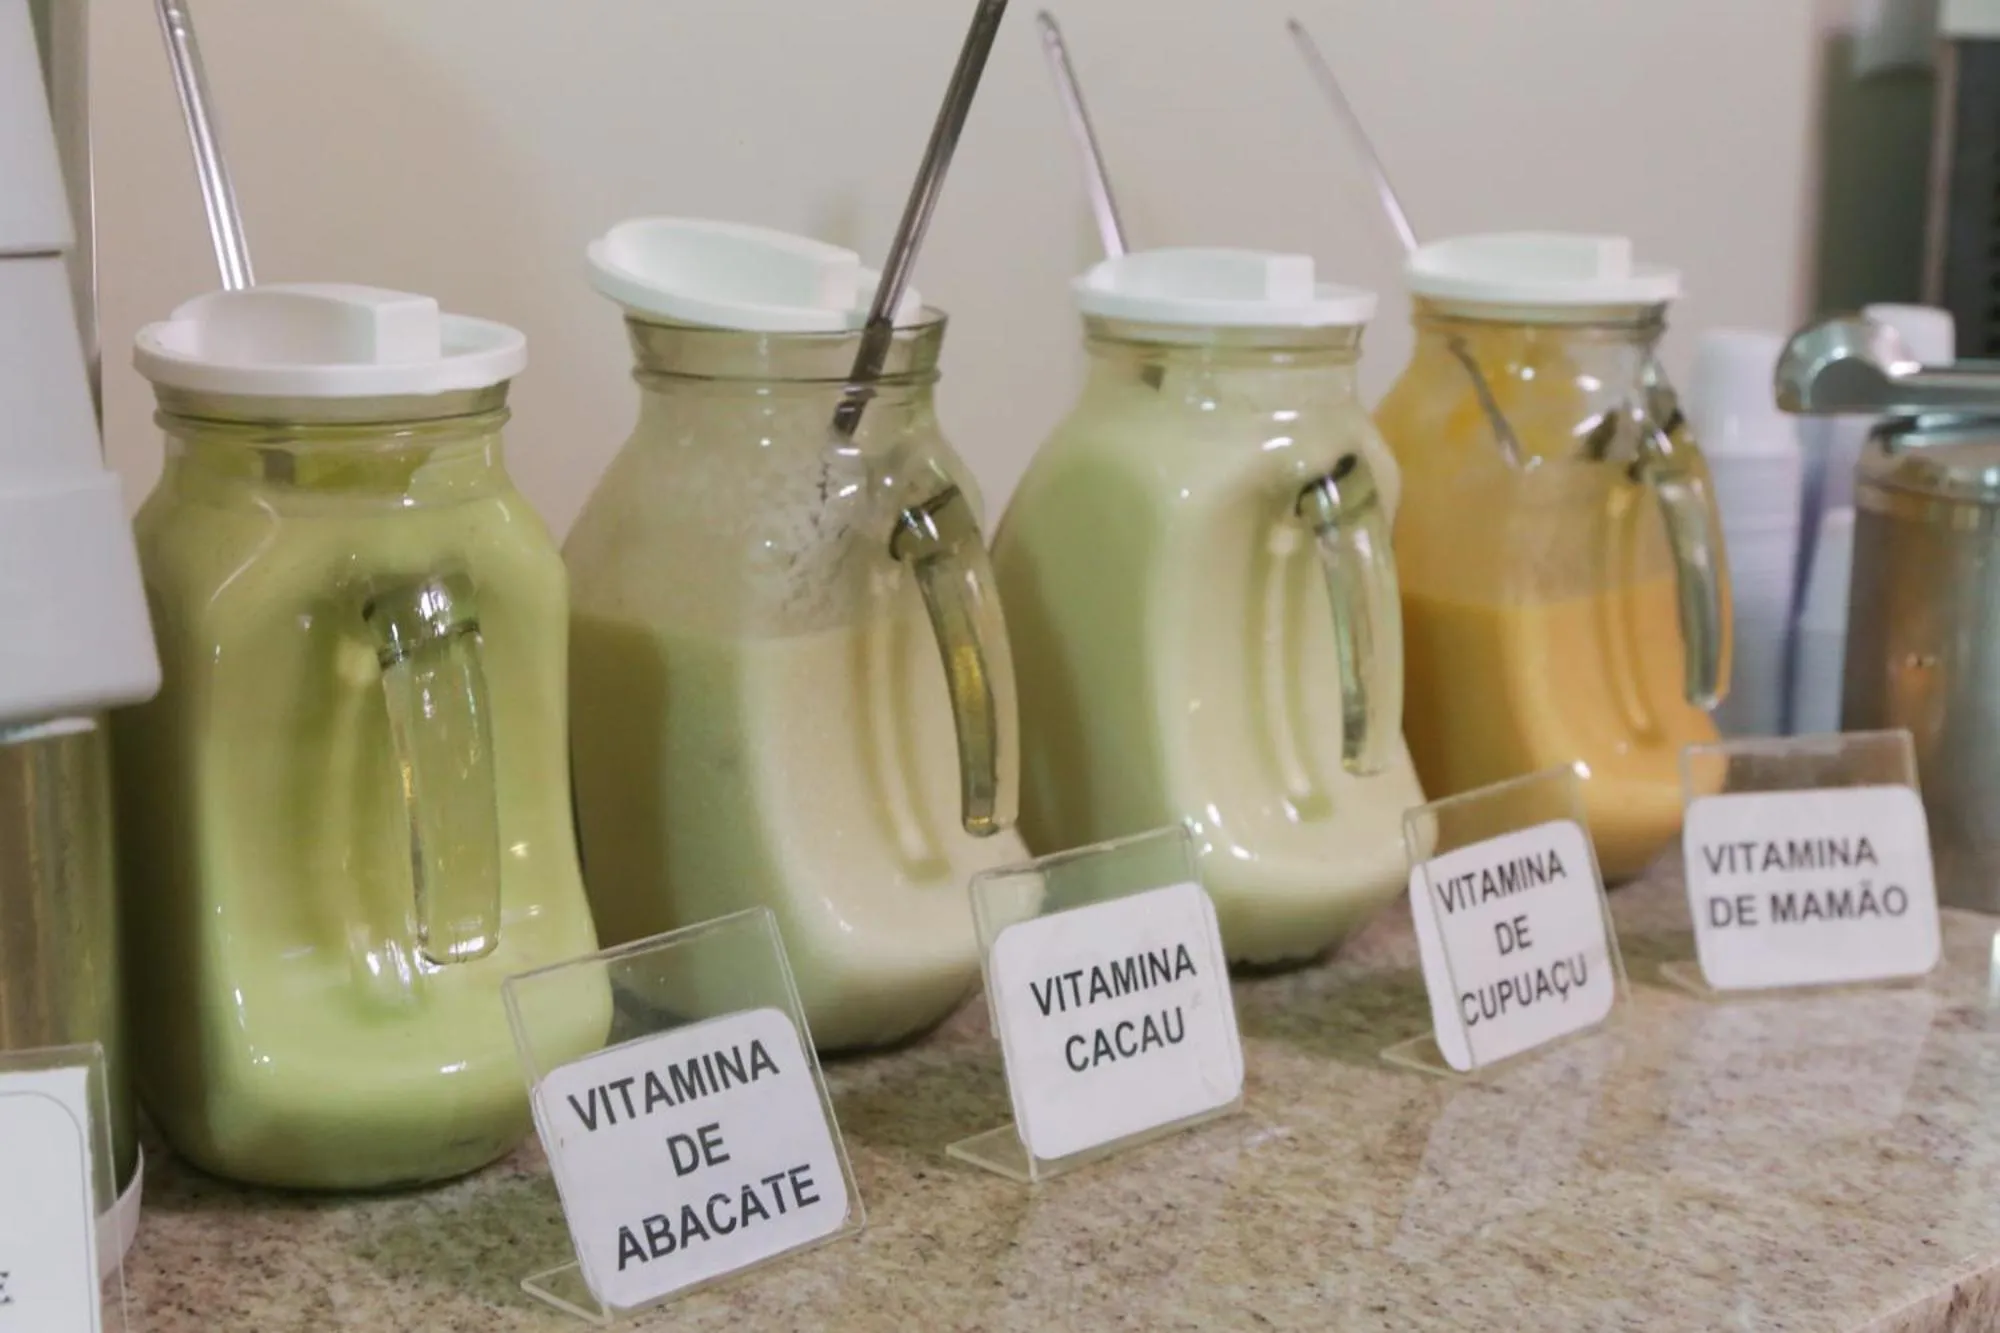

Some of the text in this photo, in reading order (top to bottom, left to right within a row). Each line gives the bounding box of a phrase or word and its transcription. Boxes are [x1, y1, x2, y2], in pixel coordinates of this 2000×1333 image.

[1437, 849, 1567, 914] VITAMINA
[1702, 836, 1878, 875] VITAMINA
[1494, 915, 1532, 956] DE
[1709, 879, 1909, 928] DE MAMÃO
[1030, 943, 1197, 1016] VITAMINA
[1461, 953, 1588, 1026] CUPUAÇU
[1065, 1007, 1185, 1072] CACAU
[567, 1039, 780, 1131] VITAMINA
[666, 1122, 731, 1177] DE
[618, 1164, 821, 1271] ABACATE
